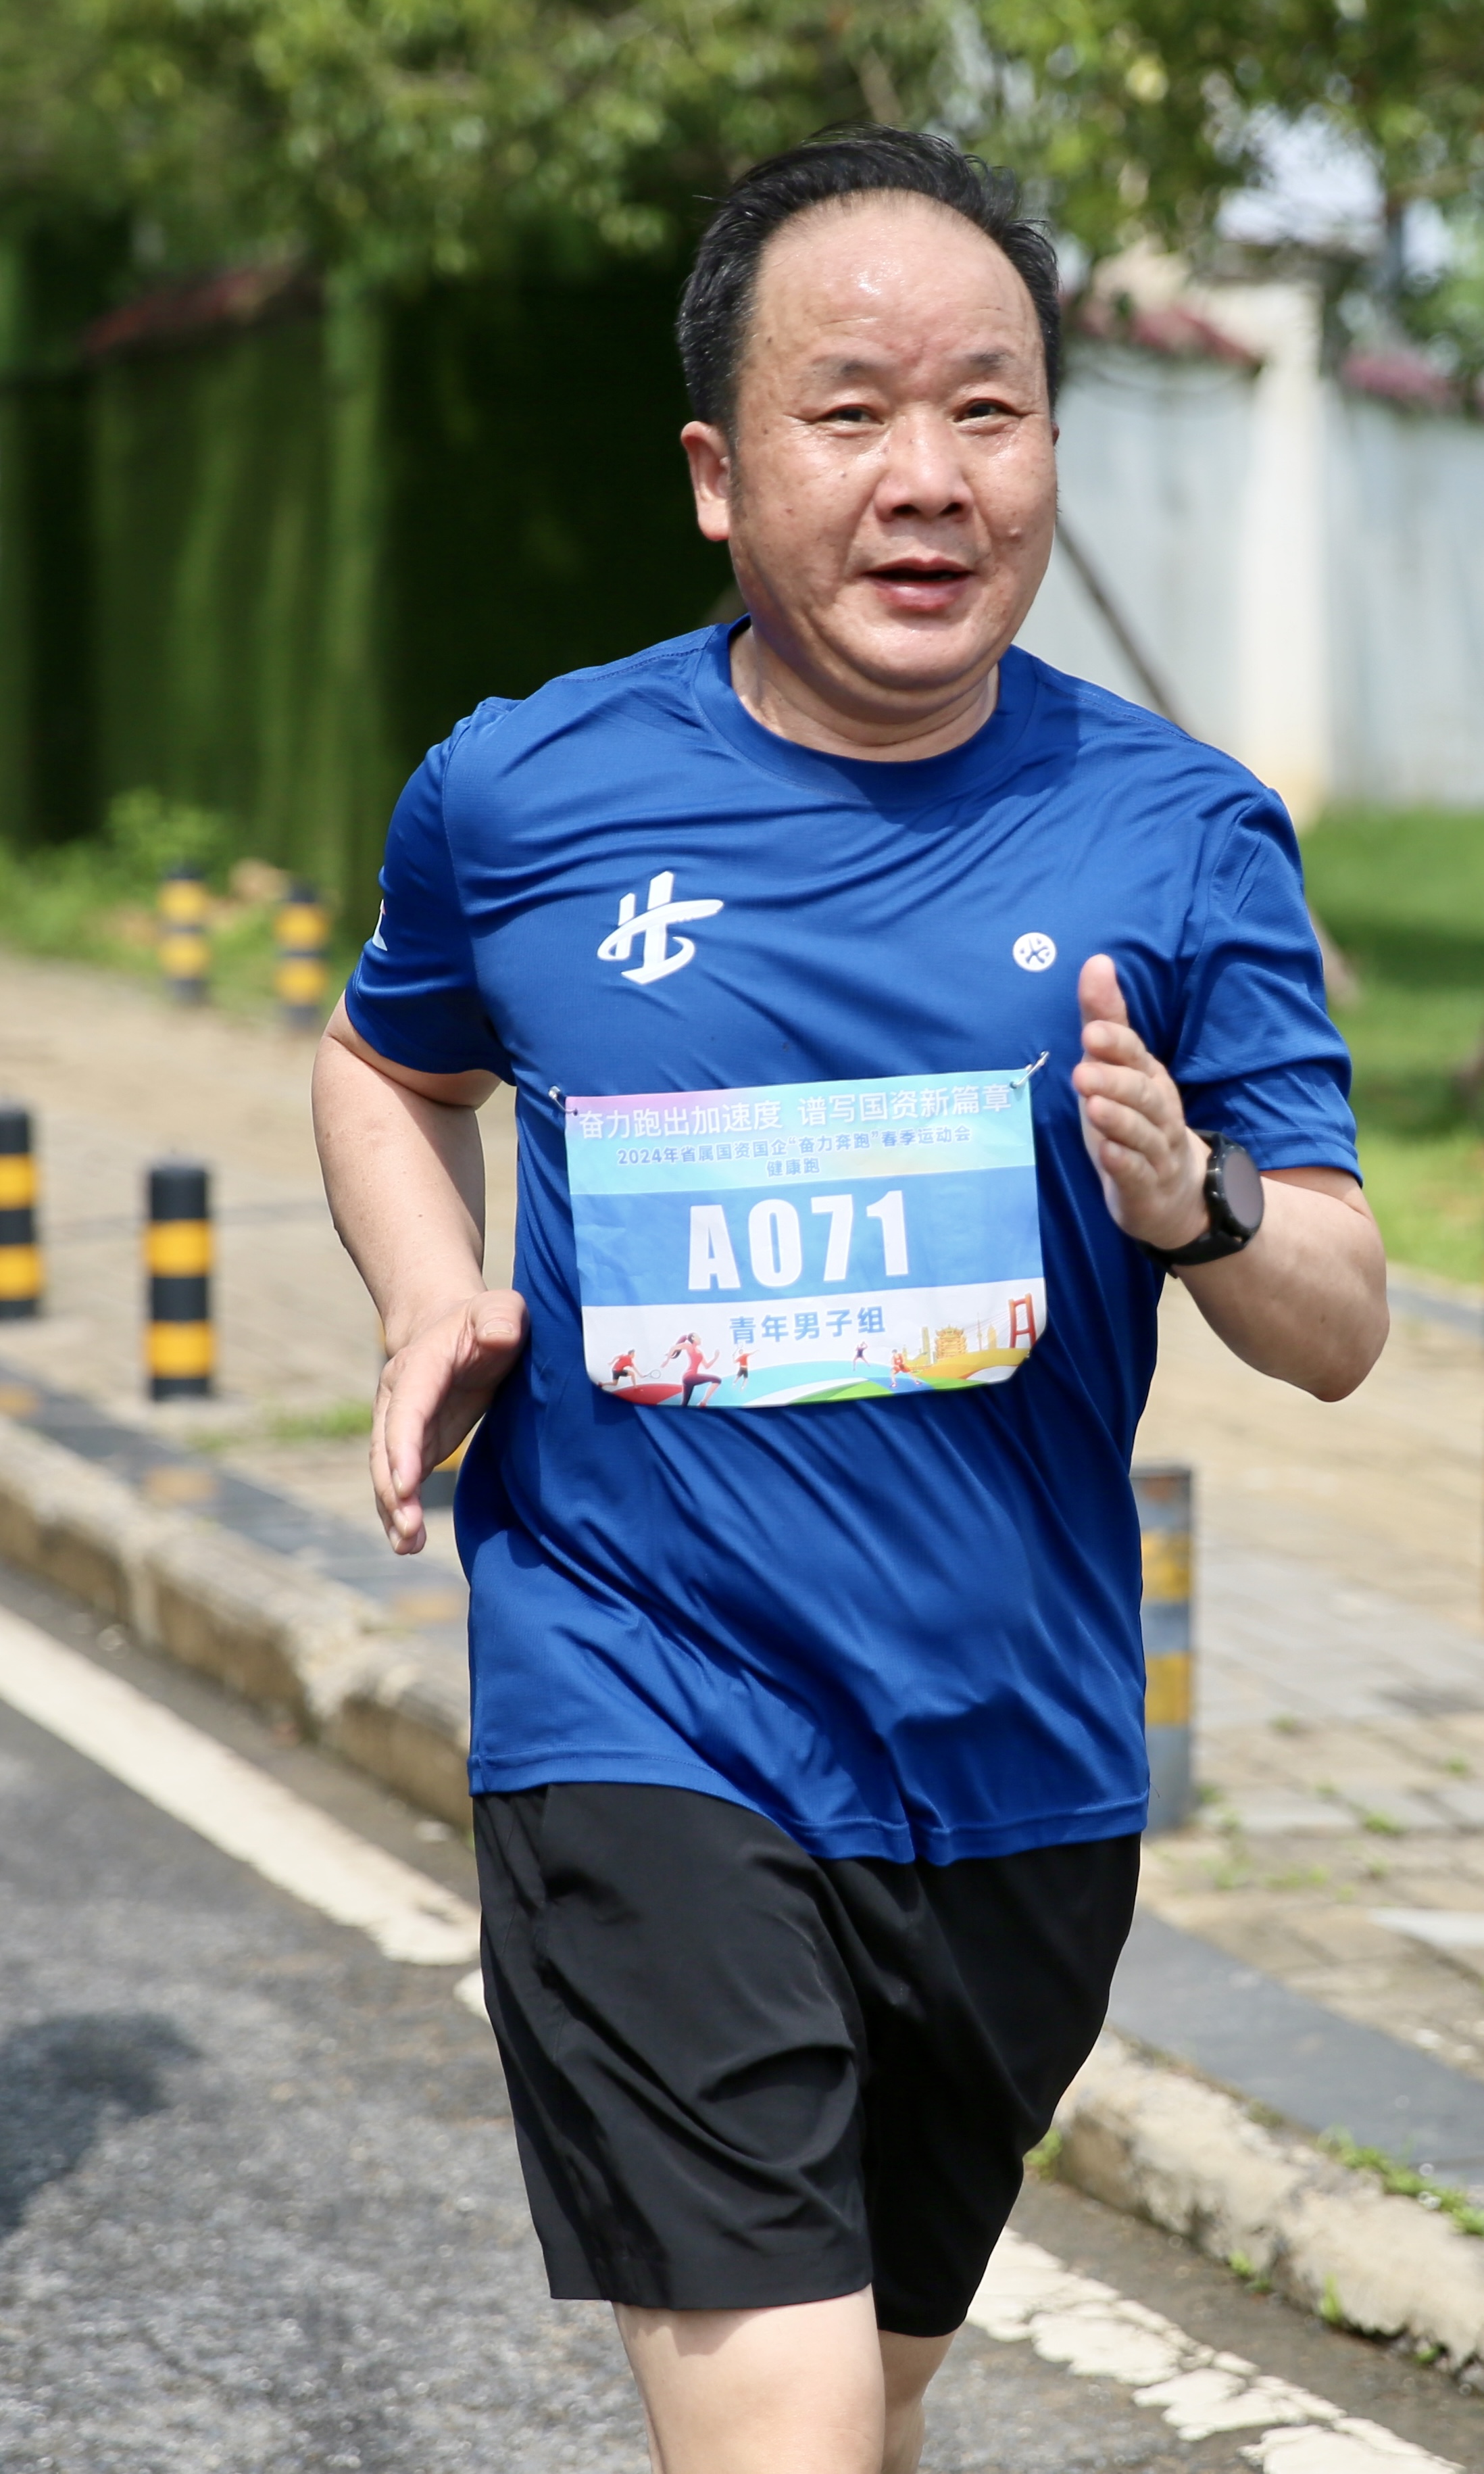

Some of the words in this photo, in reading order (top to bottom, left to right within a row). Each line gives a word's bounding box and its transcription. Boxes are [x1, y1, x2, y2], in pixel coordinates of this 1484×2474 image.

[579, 1099, 783, 1140] 奋力跑出加速度
[797, 1084, 1012, 1127] 谱写国资新篇章
[767, 1157, 820, 1178] 健康跑
[688, 1190, 909, 1290] A071
[729, 1306, 886, 1345] 青年男子组
